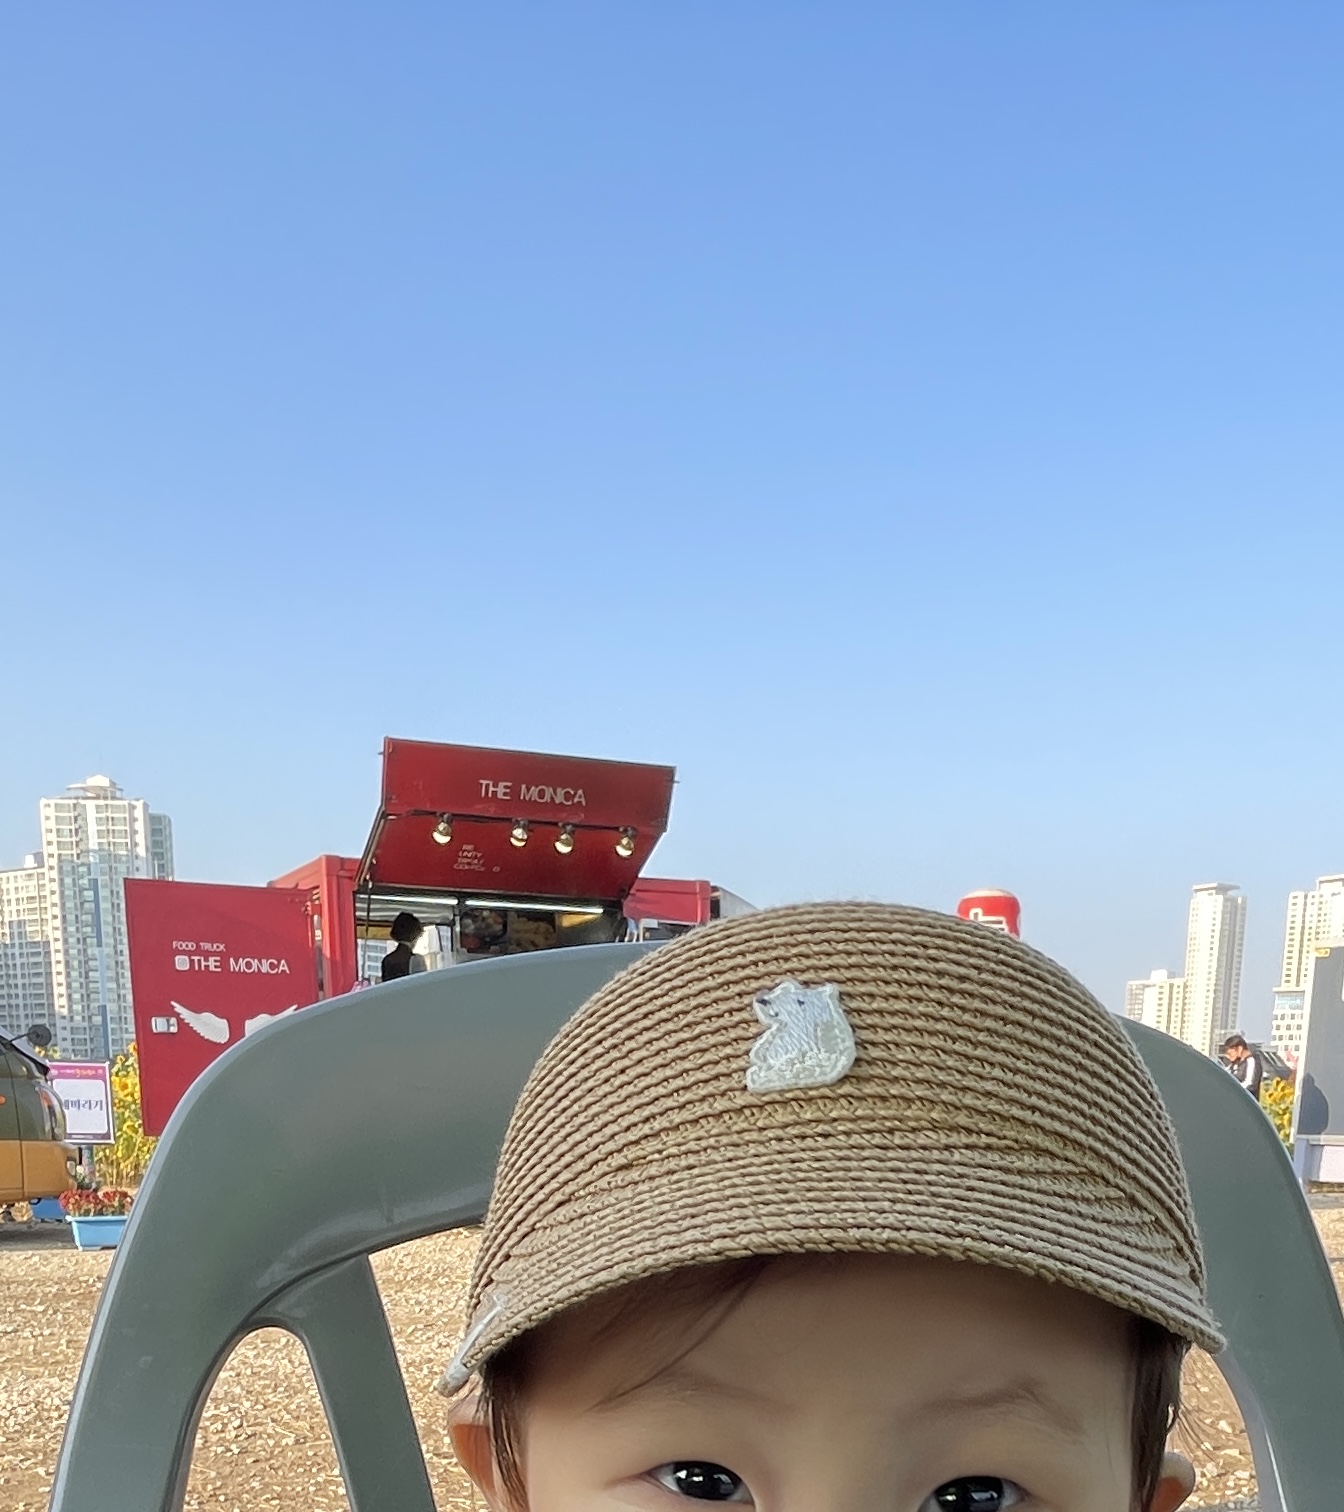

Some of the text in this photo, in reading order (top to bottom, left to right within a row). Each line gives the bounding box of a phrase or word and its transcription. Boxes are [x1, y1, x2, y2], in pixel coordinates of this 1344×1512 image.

[479, 779, 587, 806] THE MONICA
[172, 941, 226, 952] FOOD TRUCK
[191, 956, 290, 974] THE MONICA
